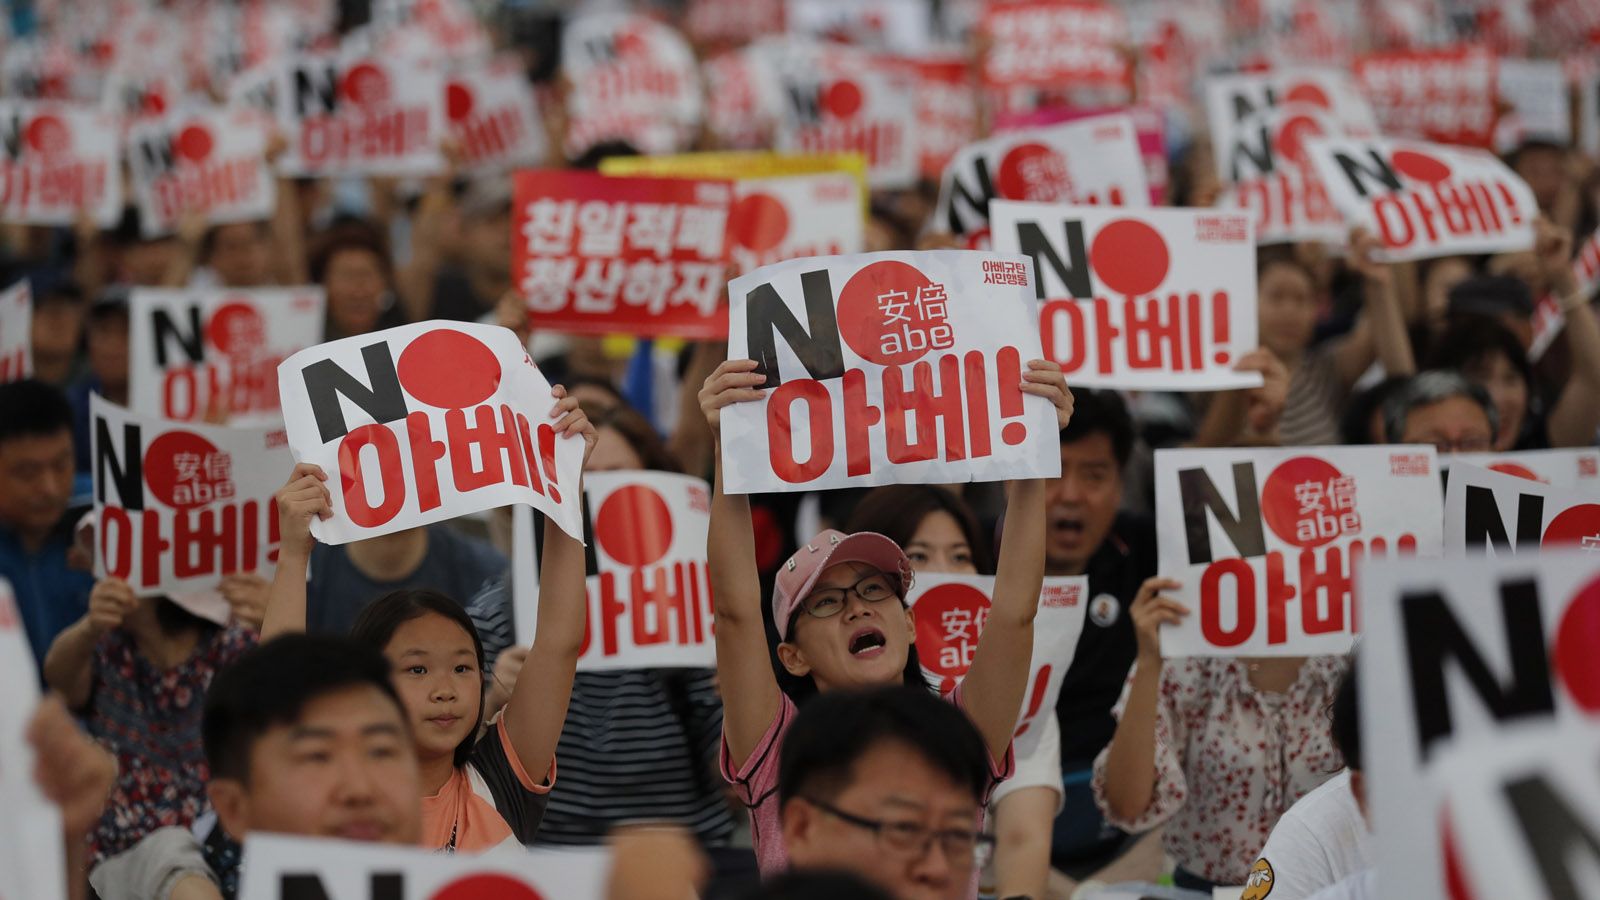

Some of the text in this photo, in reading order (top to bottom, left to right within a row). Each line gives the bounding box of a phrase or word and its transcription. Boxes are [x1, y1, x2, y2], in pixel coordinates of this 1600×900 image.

[1333, 149, 1452, 197] NO
[523, 199, 730, 258] 친일적폐
[1373, 181, 1521, 249] 아베!
[982, 260, 1026, 275] 아베규탄
[984, 272, 1028, 286] 시민행동
[1016, 218, 1170, 300] NO
[152, 302, 265, 366] NO
[746, 260, 940, 390] NO
[877, 282, 948, 326] 安倍
[1040, 291, 1231, 375] 아베!
[880, 322, 955, 356] abe
[301, 328, 501, 444] NO
[766, 345, 1027, 483] 아베!
[96, 416, 222, 511] NO
[172, 477, 237, 506] abe
[337, 403, 562, 528] 아베!
[1294, 476, 1358, 513] 安倍
[101, 494, 281, 588] 아베!
[1178, 455, 1345, 565] NO
[1295, 509, 1362, 542] abe
[1200, 531, 1417, 647] 아베
